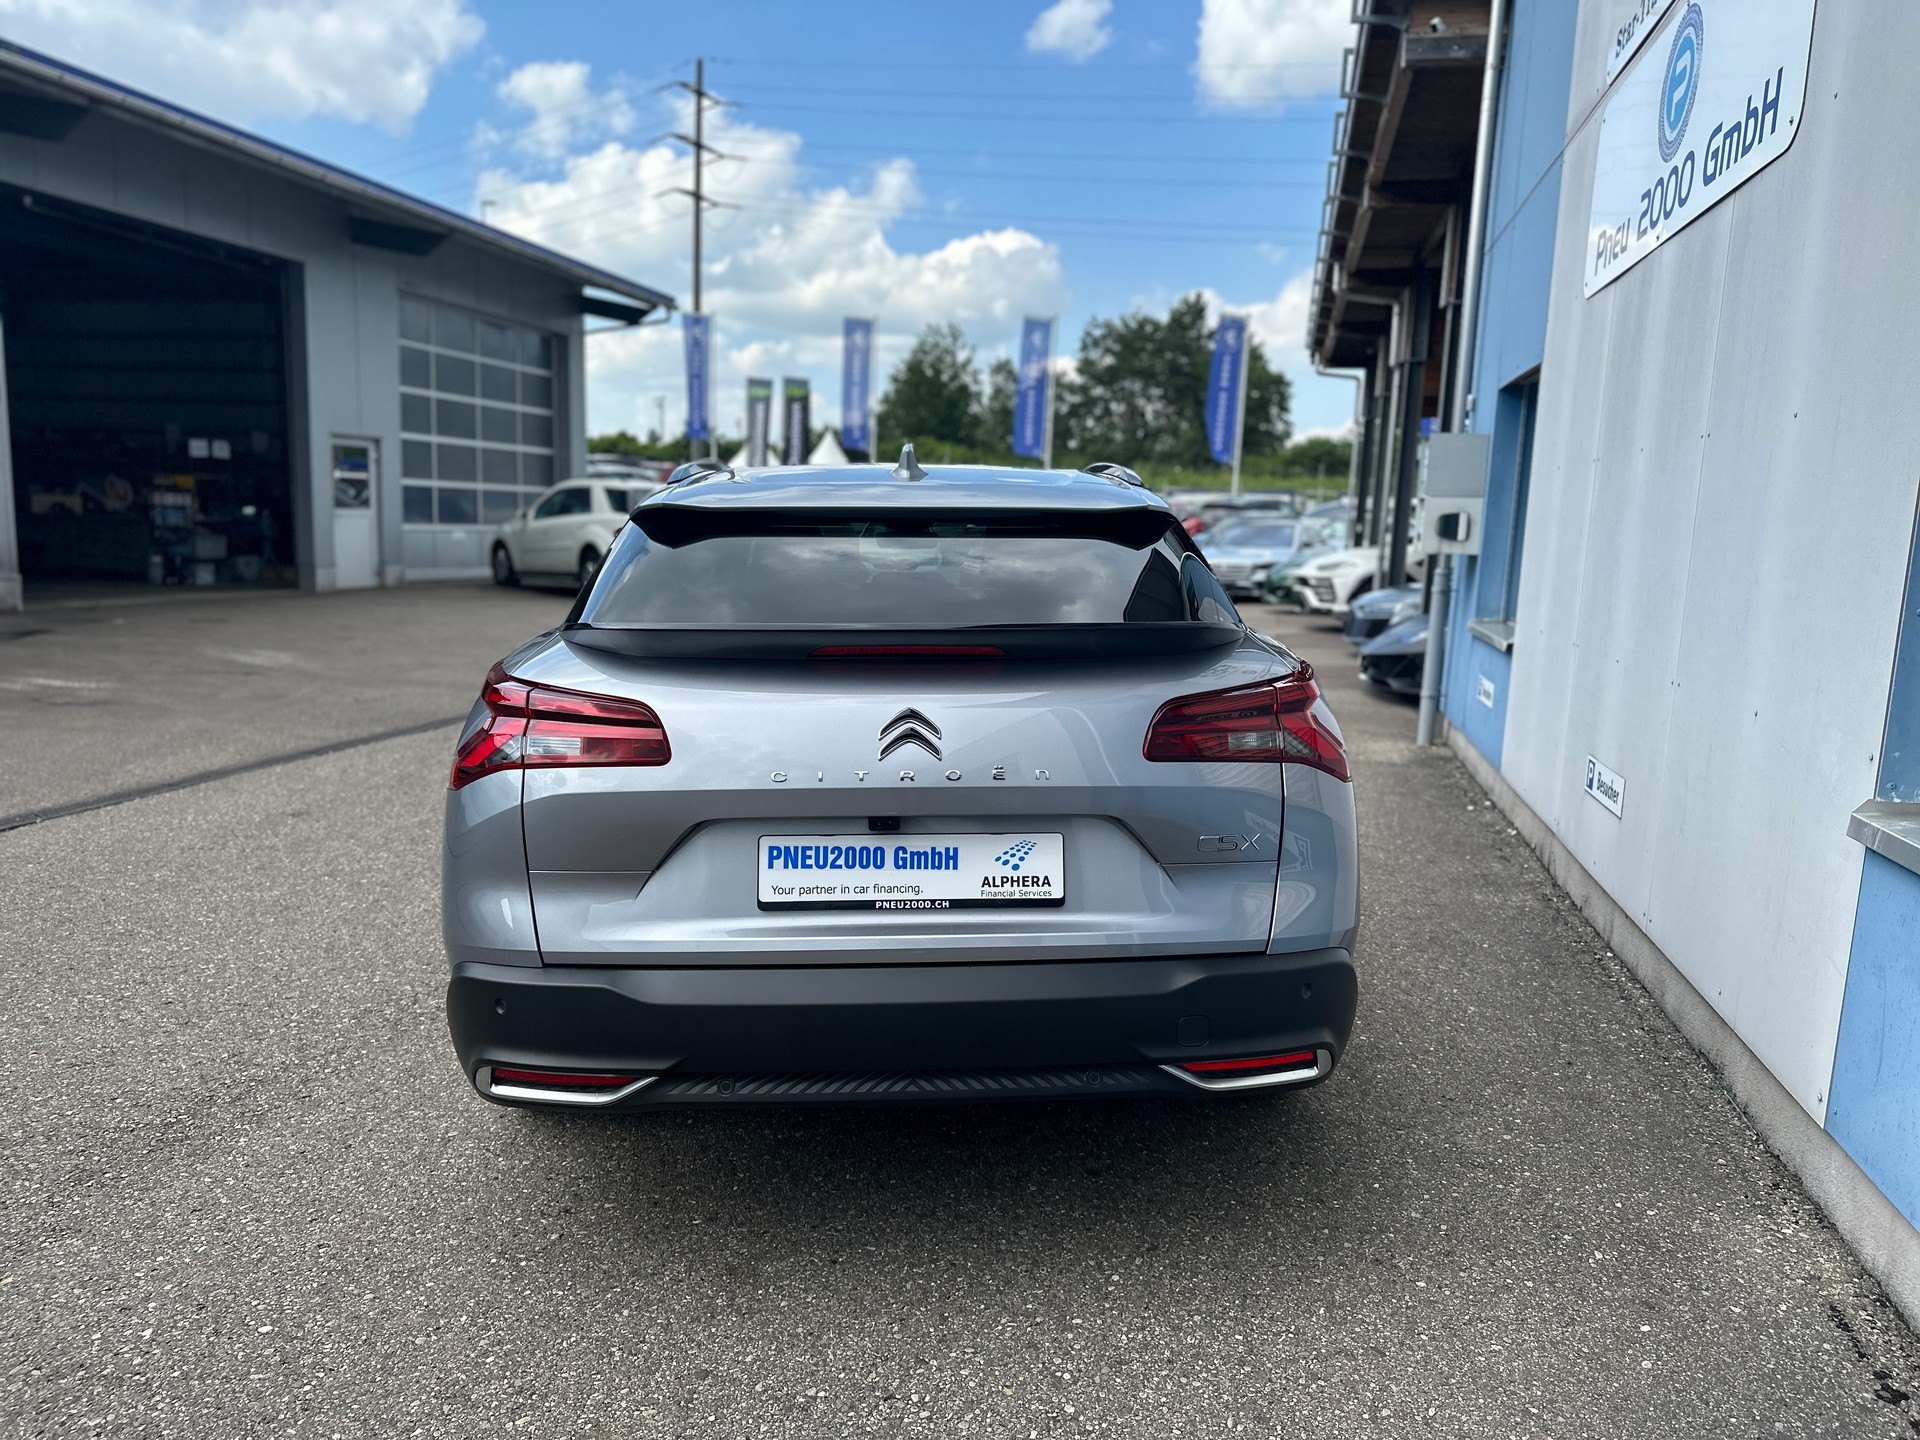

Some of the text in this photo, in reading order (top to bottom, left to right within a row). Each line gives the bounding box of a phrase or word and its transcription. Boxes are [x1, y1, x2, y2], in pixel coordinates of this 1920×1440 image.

[1636, 150, 1695, 243] 2000
[1703, 66, 1784, 187] GmbH
[1597, 771, 1620, 806] Besucher
[768, 845, 959, 871] PNEU2000 GmbH
[981, 875, 1052, 888] ALPHERA
[771, 884, 924, 897] Your partner in car financing.
[981, 889, 1053, 898] Financial Services
[875, 900, 950, 909] PNEU2000.CH
